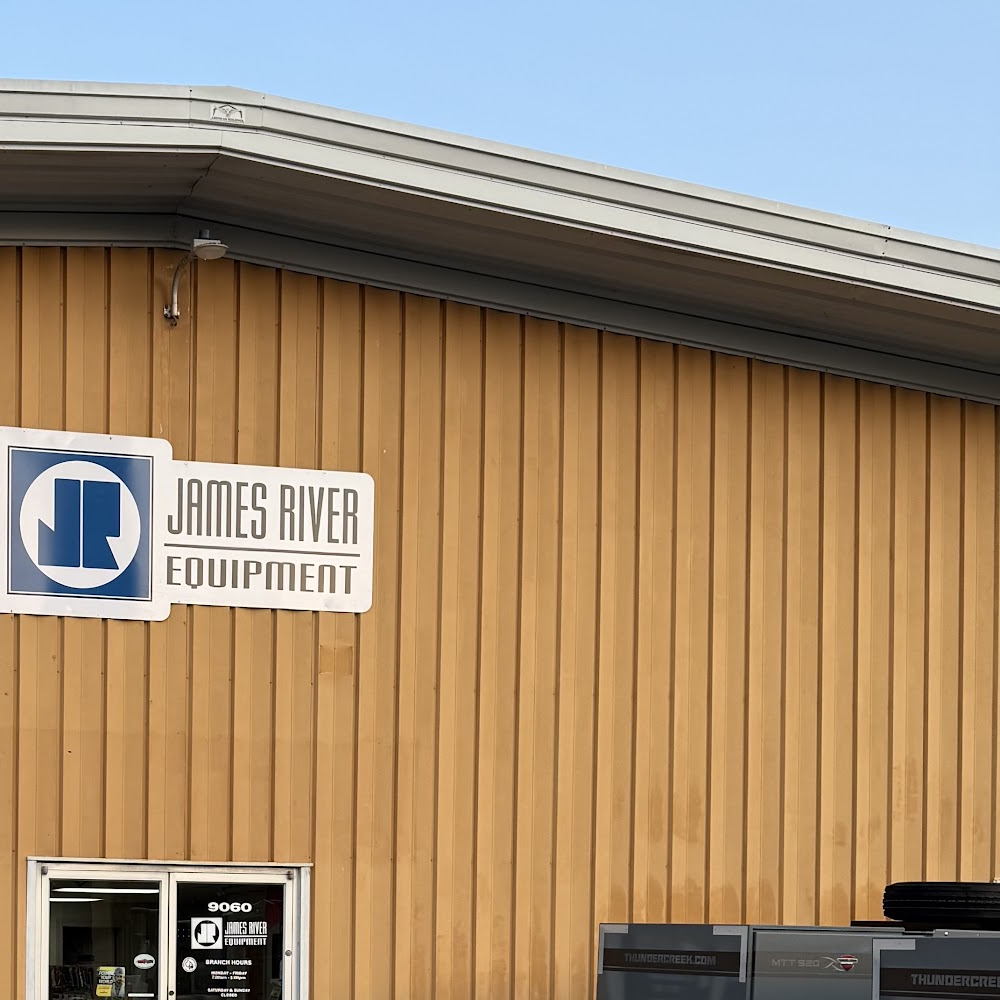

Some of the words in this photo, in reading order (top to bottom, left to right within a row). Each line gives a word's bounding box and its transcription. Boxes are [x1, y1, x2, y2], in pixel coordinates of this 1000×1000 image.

[167, 478, 267, 539] JAMES
[279, 484, 359, 545] RIVER
[166, 556, 358, 595] EQUIPMENT
[207, 902, 252, 912] 9060
[224, 921, 247, 935] JAMES
[248, 922, 267, 935] RIVER
[224, 938, 267, 946] EQUIPMENT
[624, 953, 716, 966] THUNDERCREEK.COM
[771, 958, 796, 967] MTT
[798, 959, 820, 967] 920
